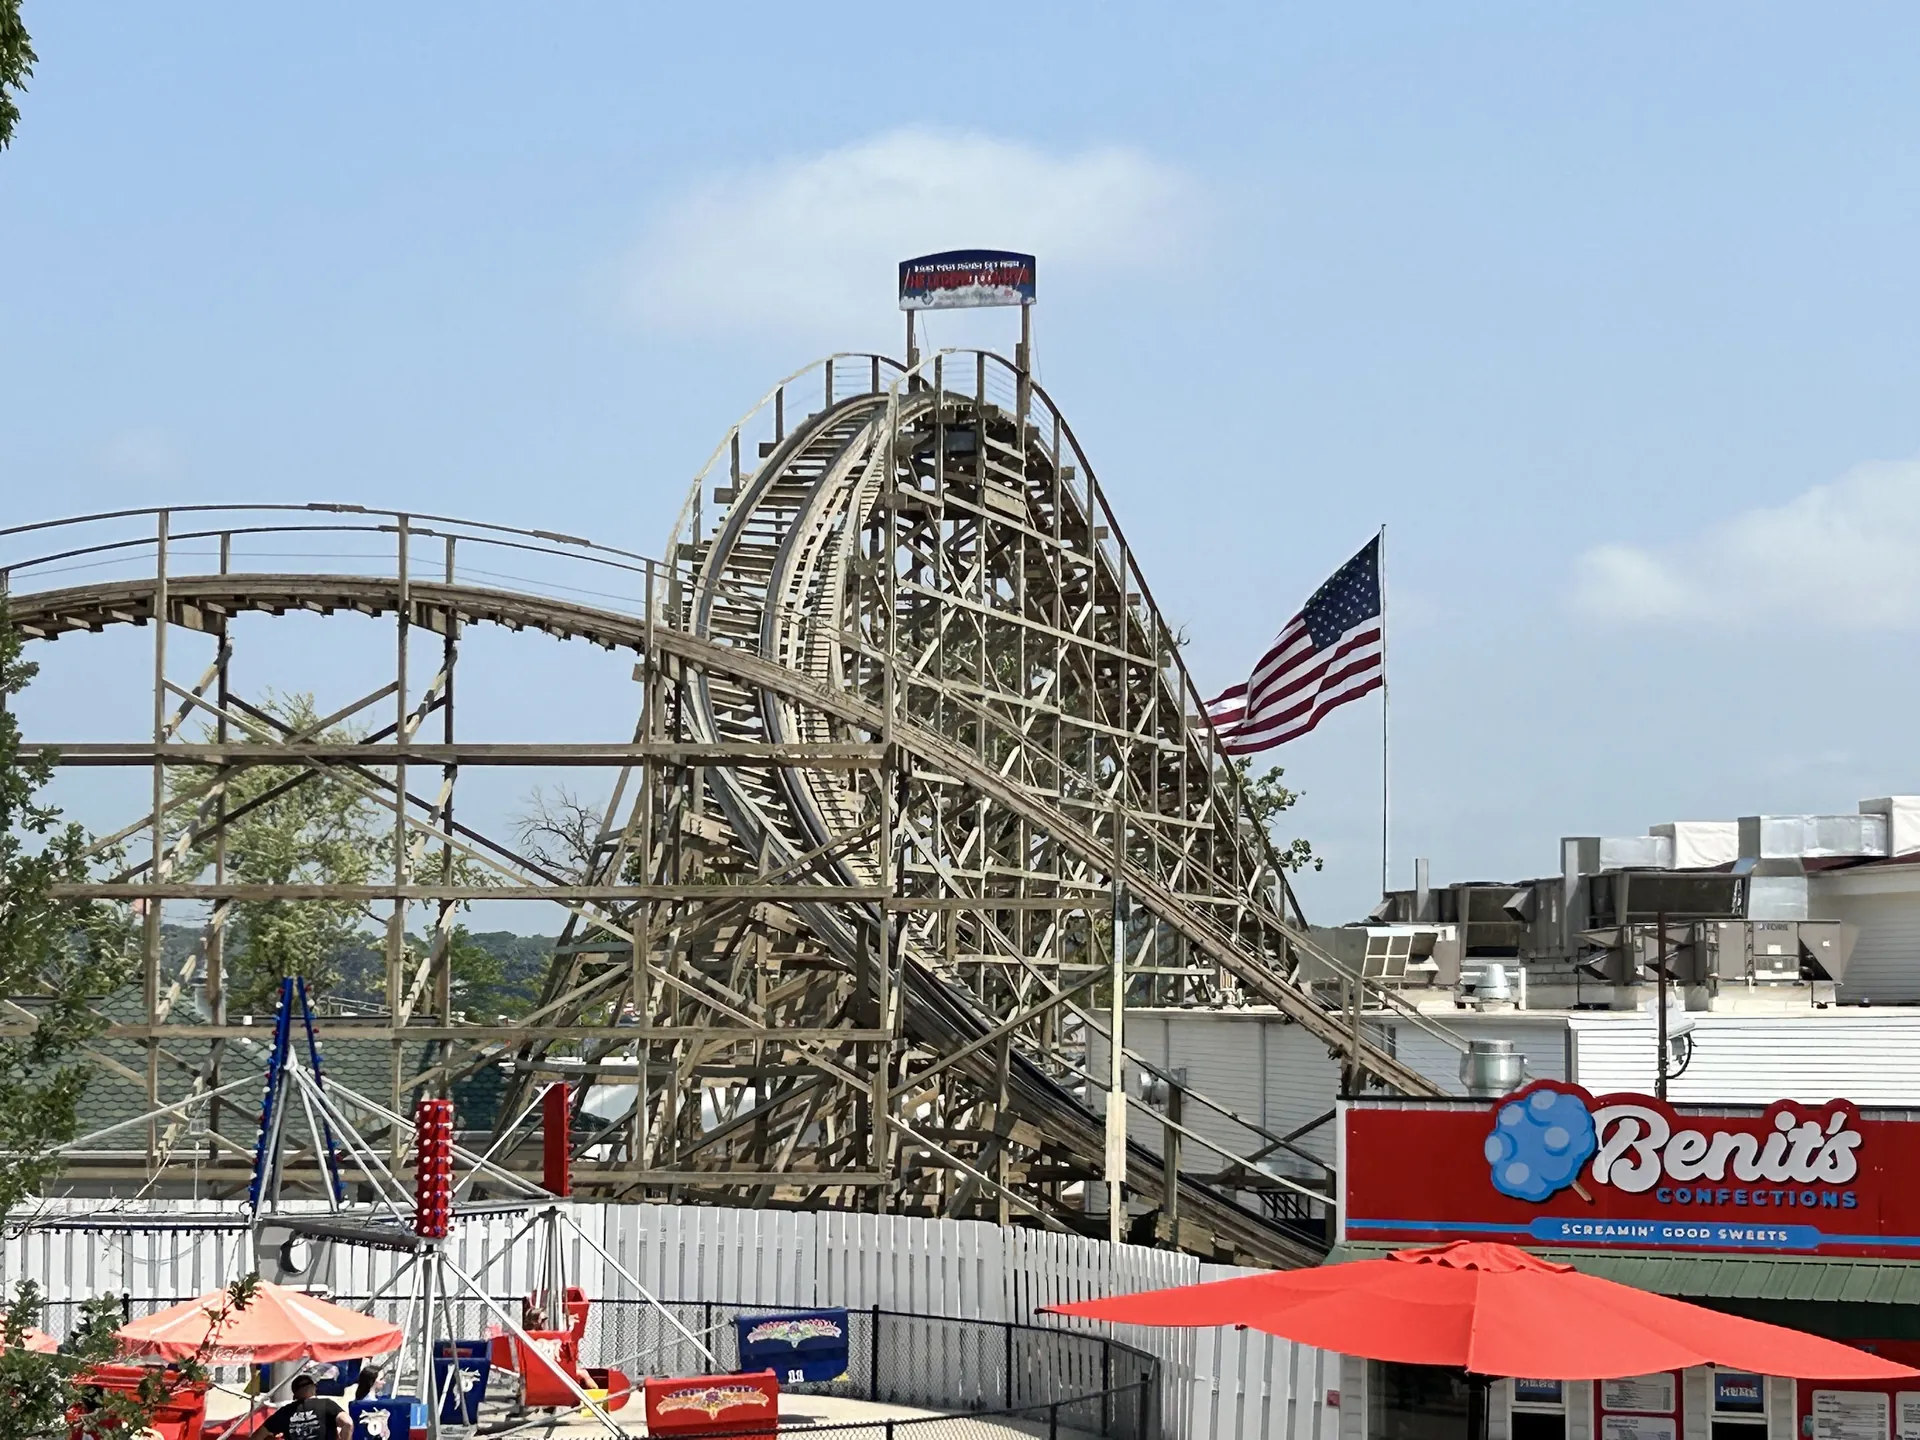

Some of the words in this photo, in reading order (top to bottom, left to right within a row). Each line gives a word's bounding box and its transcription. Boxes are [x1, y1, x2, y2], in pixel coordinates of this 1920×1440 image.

[1591, 1104, 1862, 1193] Benit's
[1655, 1187, 1858, 1209] CONFECTIONS
[1561, 1223, 1655, 1238] SCREAMIN'
[1662, 1227, 1711, 1240] GOOD
[1718, 1229, 1788, 1242] SWEETS
